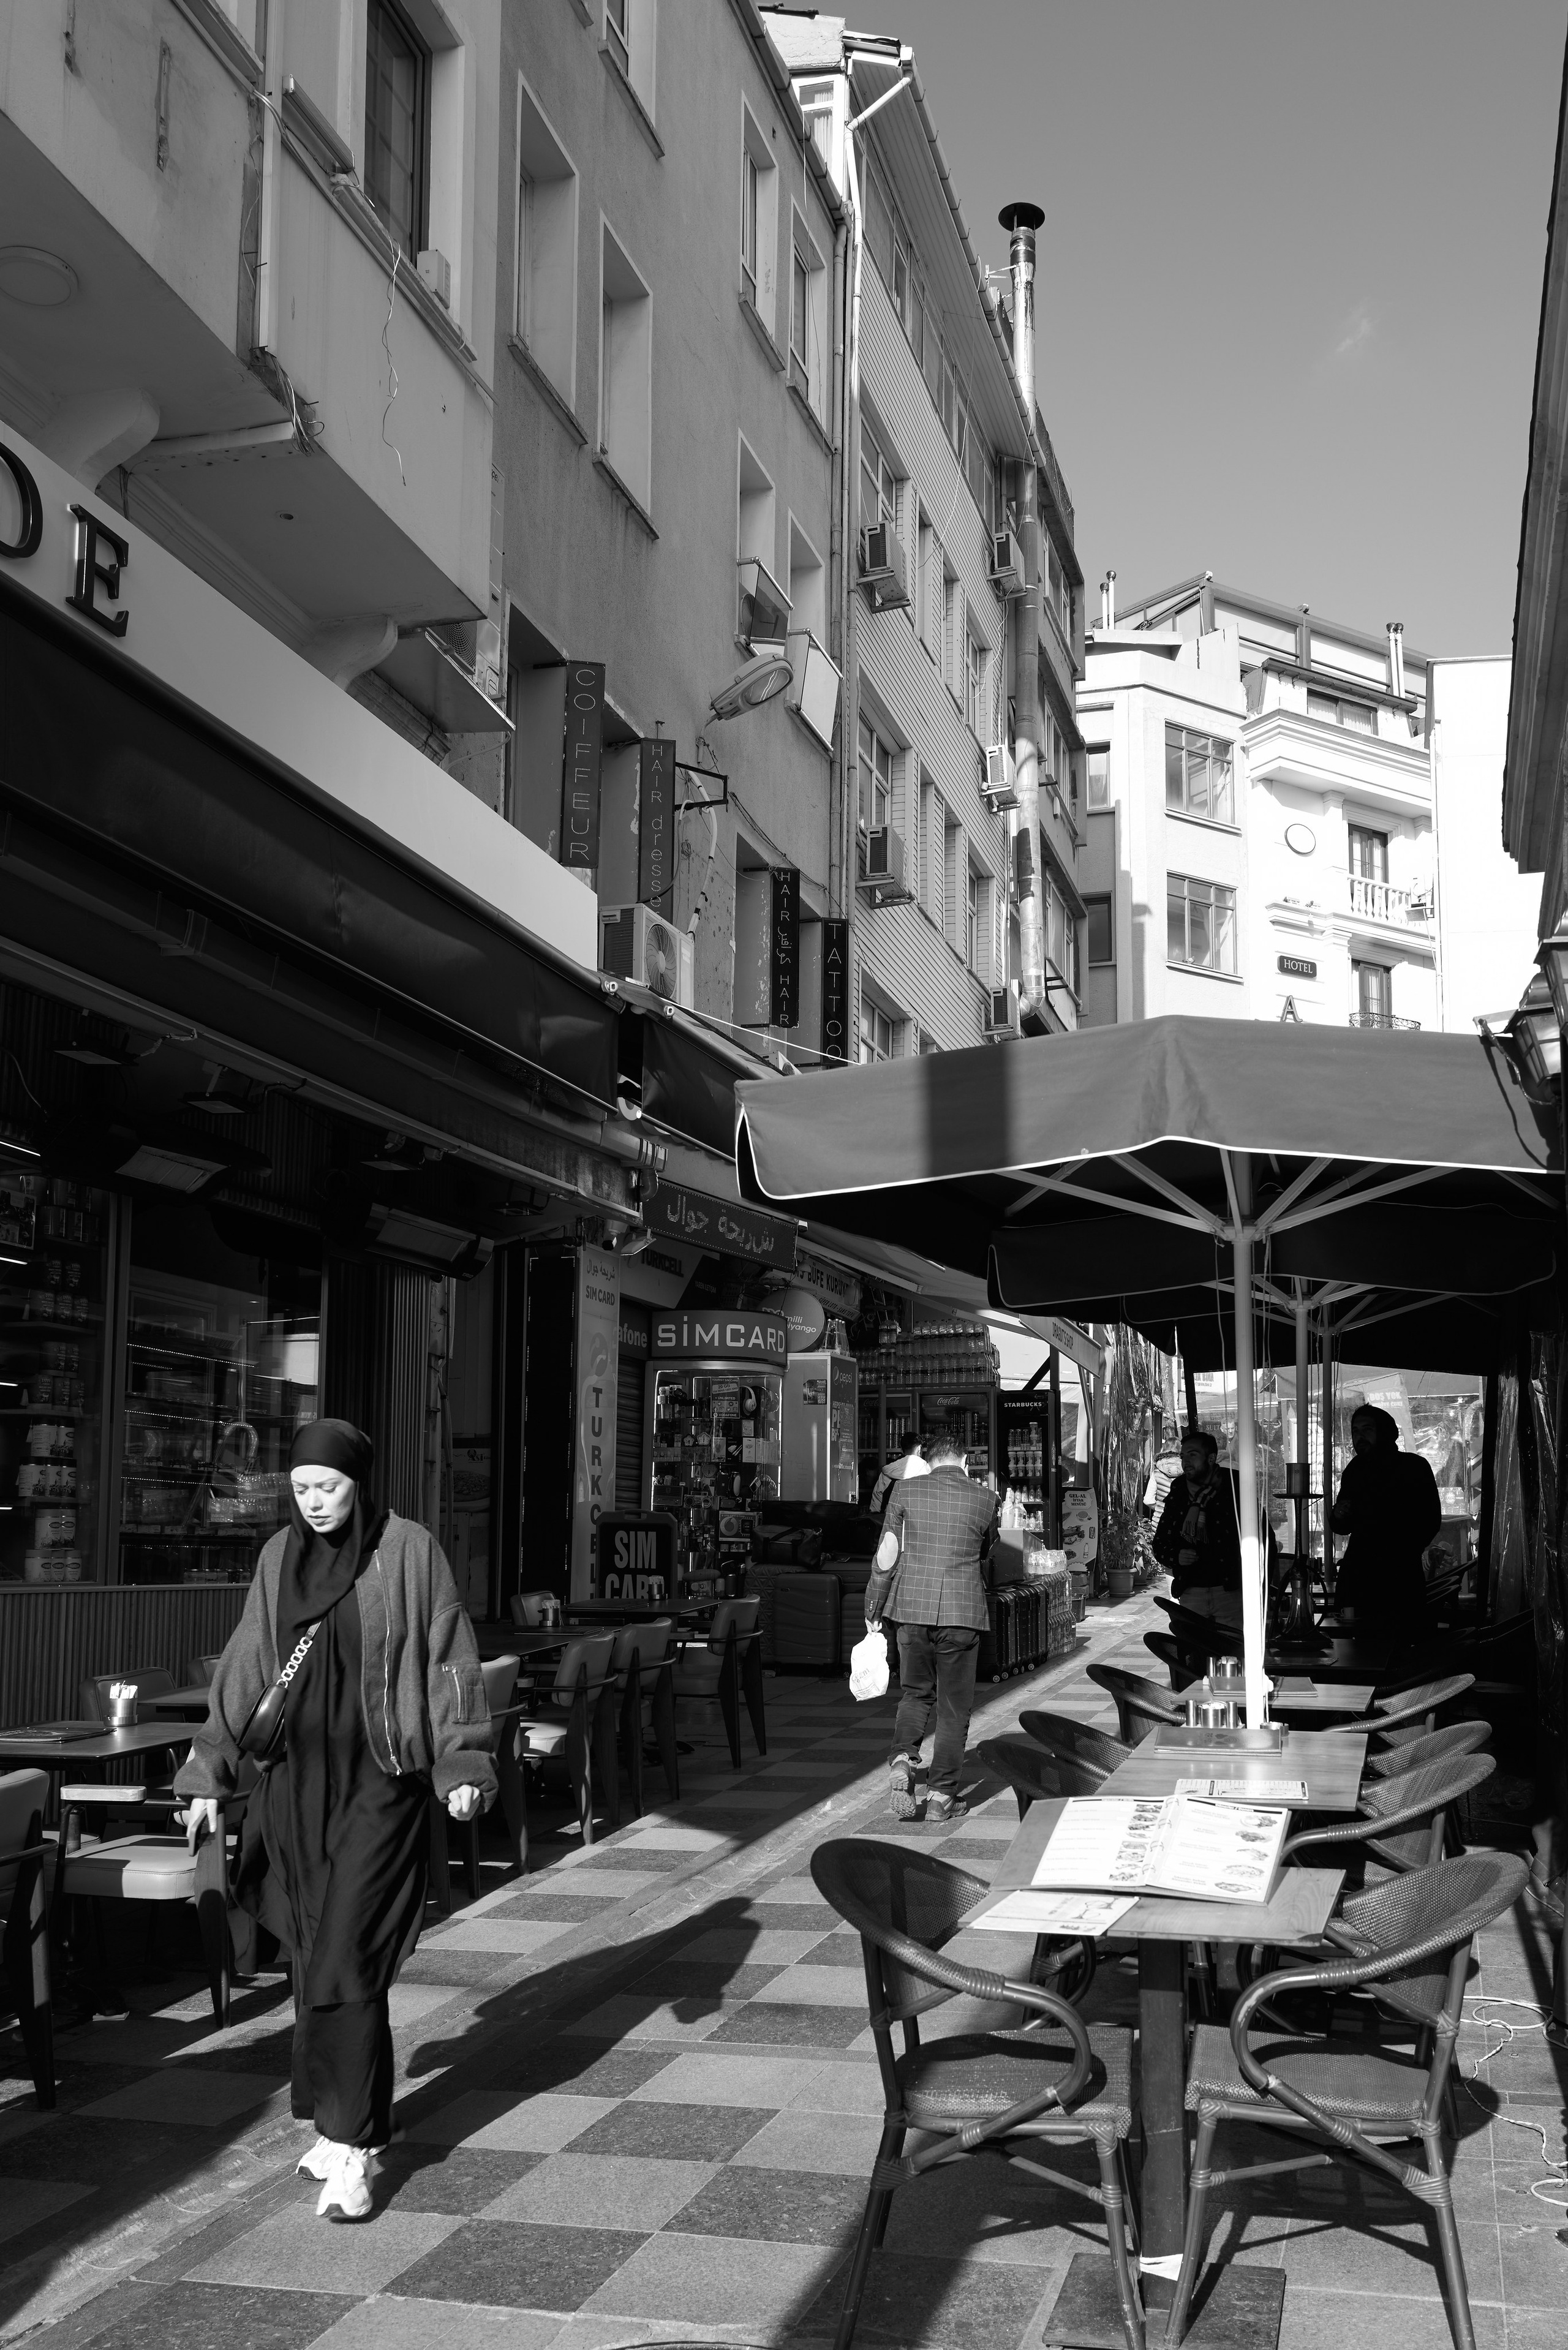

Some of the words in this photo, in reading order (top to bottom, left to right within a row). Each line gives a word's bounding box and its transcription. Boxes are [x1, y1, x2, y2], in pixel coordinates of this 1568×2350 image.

[570, 669, 595, 861] COIFFEUR
[650, 744, 663, 803] HAIR
[780, 872, 790, 922] HAIR
[1283, 958, 1313, 975] HOTEL
[779, 975, 790, 1025] HAIR
[826, 923, 842, 1061] TATTOO
[666, 1194, 709, 1233] جوال
[641, 1247, 684, 1278] TURKCELL
[586, 1284, 597, 1301] SIM
[598, 1288, 616, 1306] CARD
[826, 1273, 849, 1297] KURUY
[618, 1323, 647, 1348] afone
[786, 1323, 816, 1333] iyango
[839, 1372, 853, 1385] pepsi
[614, 1530, 657, 1569] SIM
[605, 1573, 651, 1599] CAR
